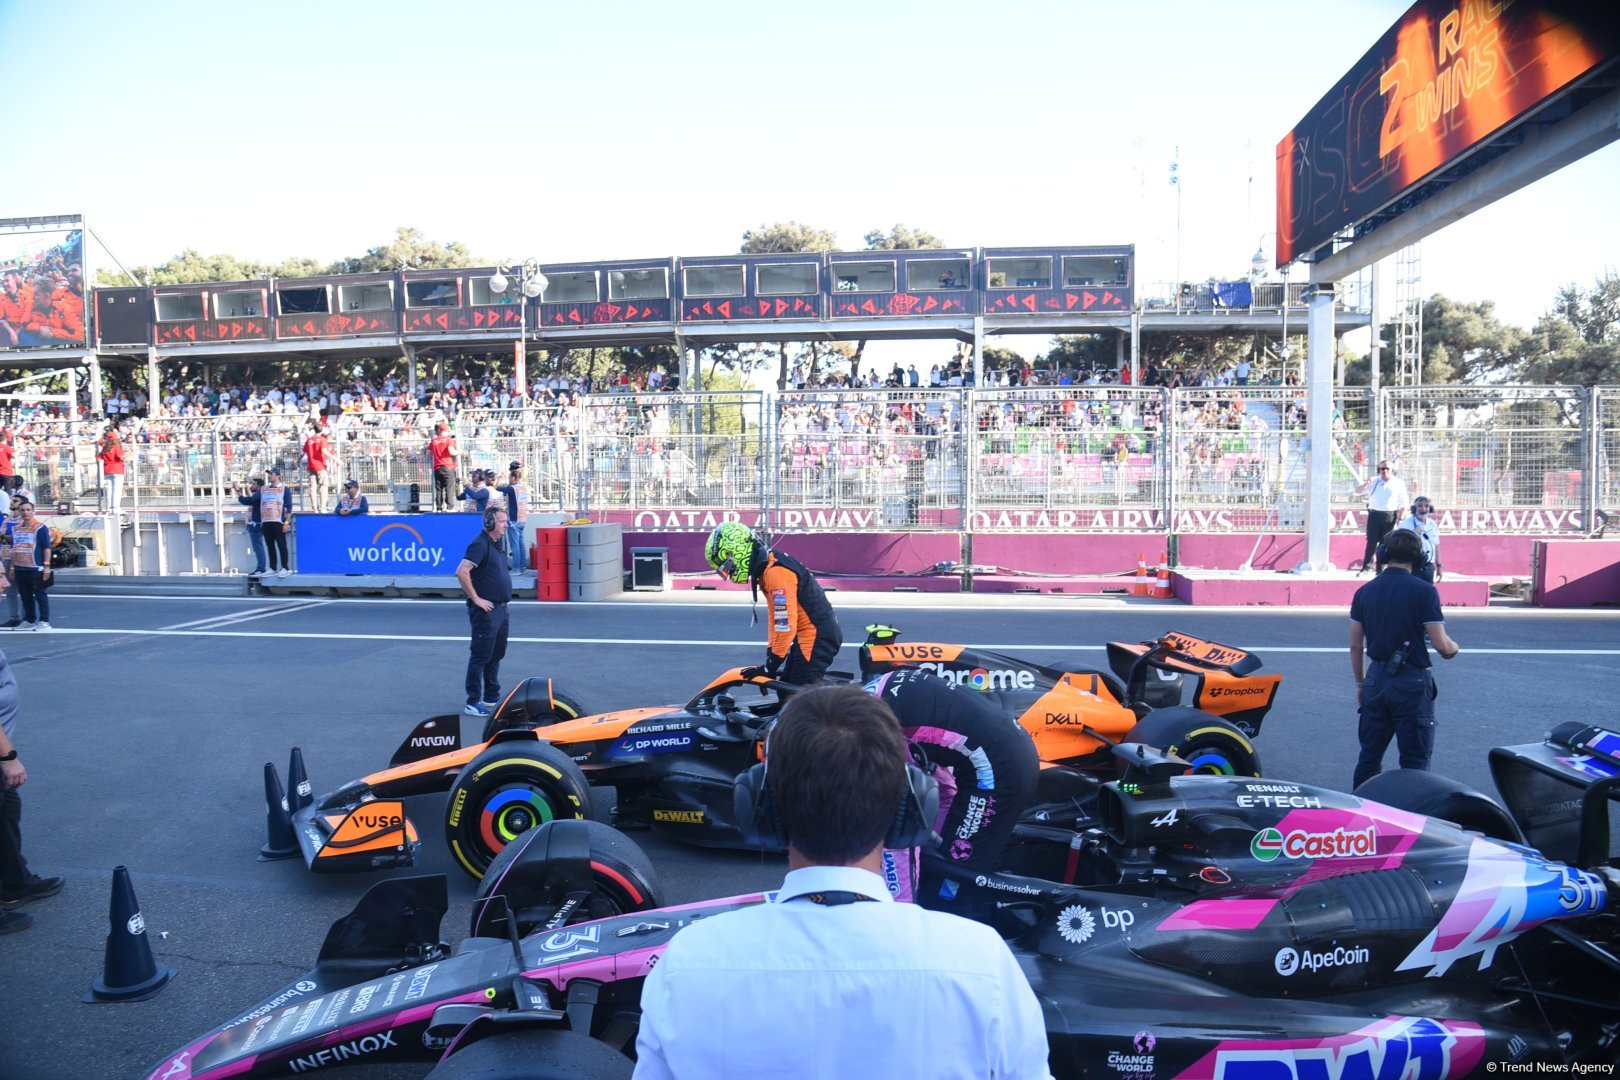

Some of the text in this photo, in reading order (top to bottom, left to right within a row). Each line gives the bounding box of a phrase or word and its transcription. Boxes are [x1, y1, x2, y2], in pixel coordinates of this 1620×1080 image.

[1439, 0, 1514, 65] RAC
[1416, 28, 1498, 132] WINS
[634, 510, 883, 532] QATAR AIRWAY
[968, 511, 1233, 533] QATAR AIRWAYS
[1223, 687, 1265, 697] Dropbox
[627, 722, 691, 735] RICHARD MILLE
[1045, 712, 1082, 725] DELL
[410, 735, 456, 748] ARROW
[635, 739, 651, 749] DP
[652, 736, 691, 747] WORLD
[1246, 784, 1301, 794] RENAULT
[449, 788, 468, 828] PIRELLI
[1236, 795, 1322, 809] E-TECH
[959, 795, 979, 840] CHANGE
[969, 797, 986, 838] WORLD
[1285, 827, 1375, 857] Castrol
[987, 879, 1041, 896] businessolver
[545, 899, 577, 930] ALPINE
[1101, 907, 1134, 932] bp
[1301, 947, 1370, 970] ApeCoin
[289, 1030, 398, 1073] INFINOX
[1108, 1055, 1154, 1064] CHANGE
[1116, 1064, 1154, 1073] WORLD
